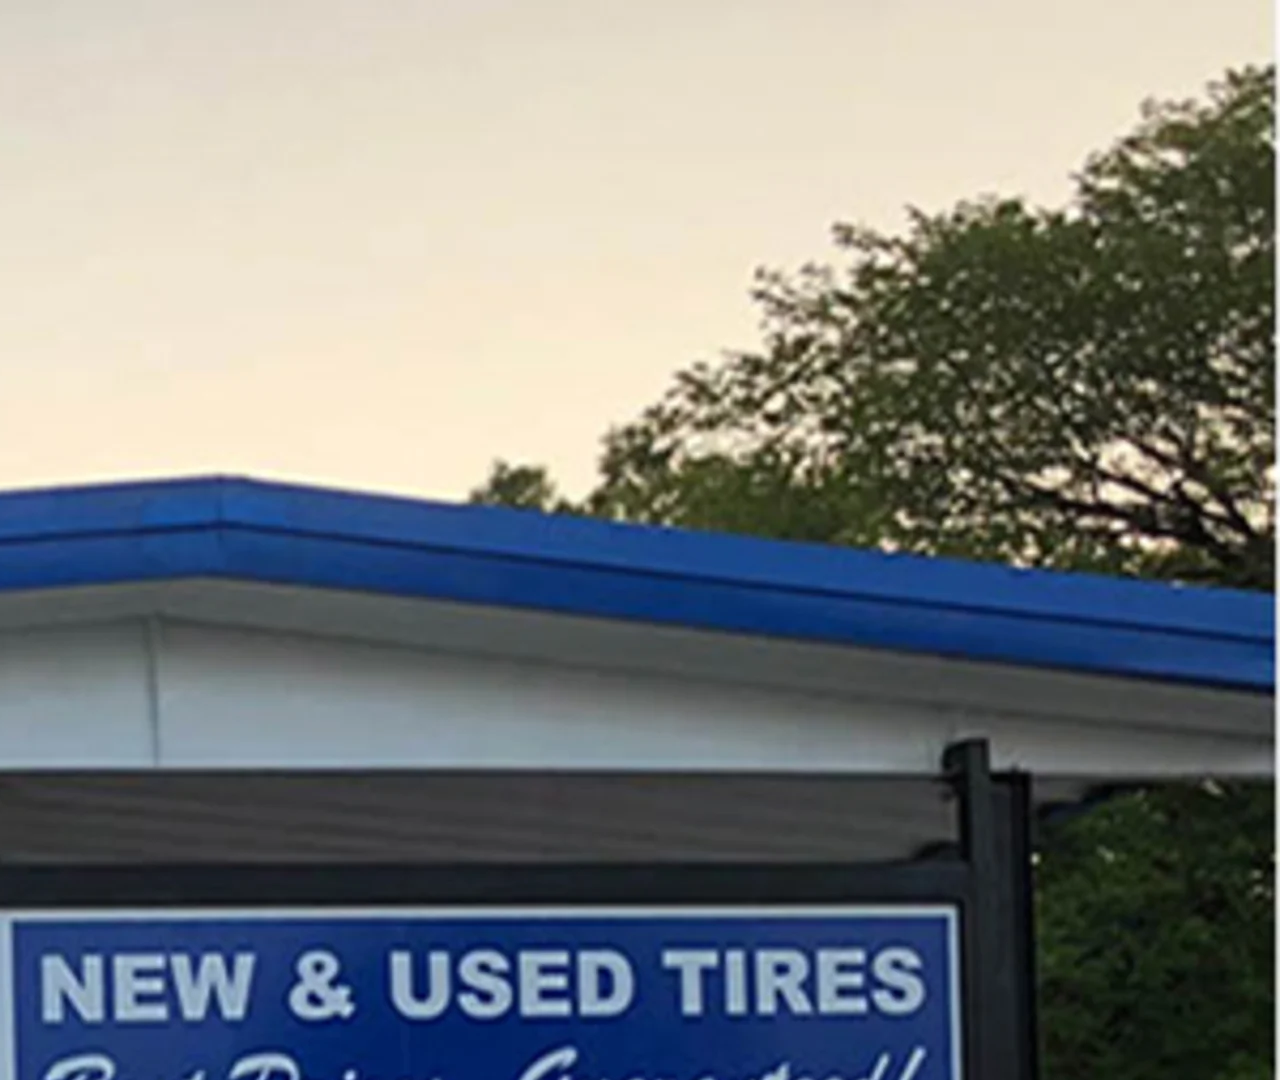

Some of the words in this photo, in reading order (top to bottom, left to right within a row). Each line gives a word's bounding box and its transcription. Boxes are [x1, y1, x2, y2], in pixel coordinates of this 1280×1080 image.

[39, 951, 255, 1023] NEW
[287, 949, 356, 1021] &
[387, 948, 635, 1020] USED
[660, 945, 927, 1017] TIRES
